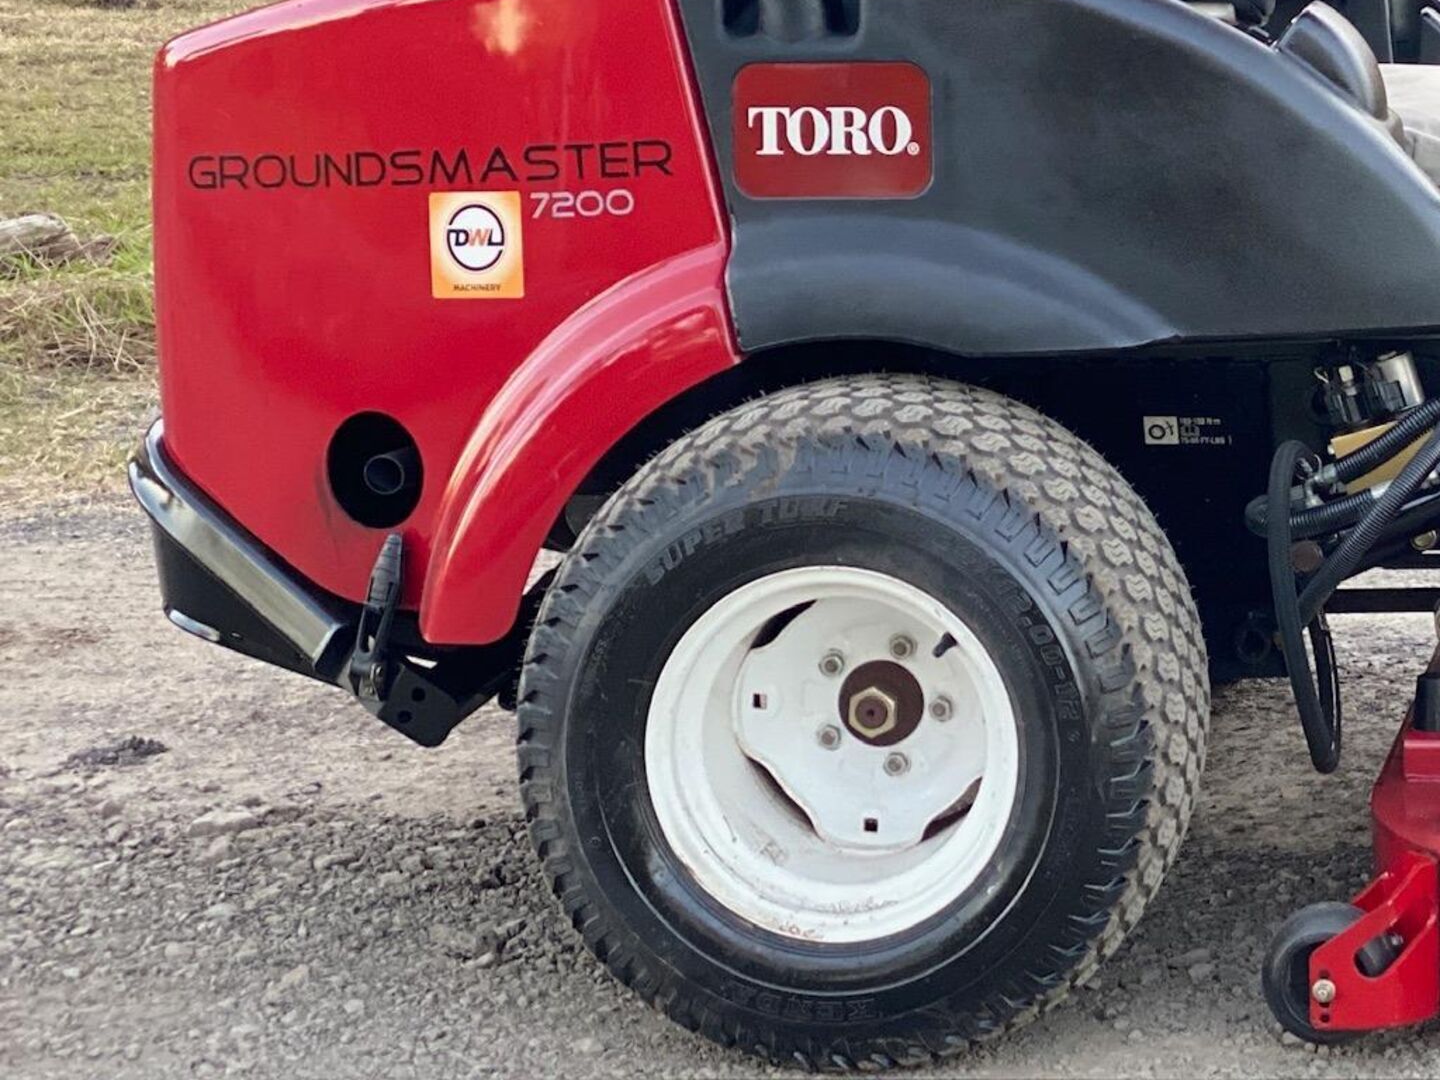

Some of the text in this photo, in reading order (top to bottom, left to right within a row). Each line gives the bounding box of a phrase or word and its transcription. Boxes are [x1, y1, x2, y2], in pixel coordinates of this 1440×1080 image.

[188, 139, 674, 190] GROUNDSMASTER
[530, 189, 635, 219] 7200
[449, 228, 504, 247] DWL
[453, 283, 501, 292] MACHINERY
[643, 508, 746, 586] SUPER
